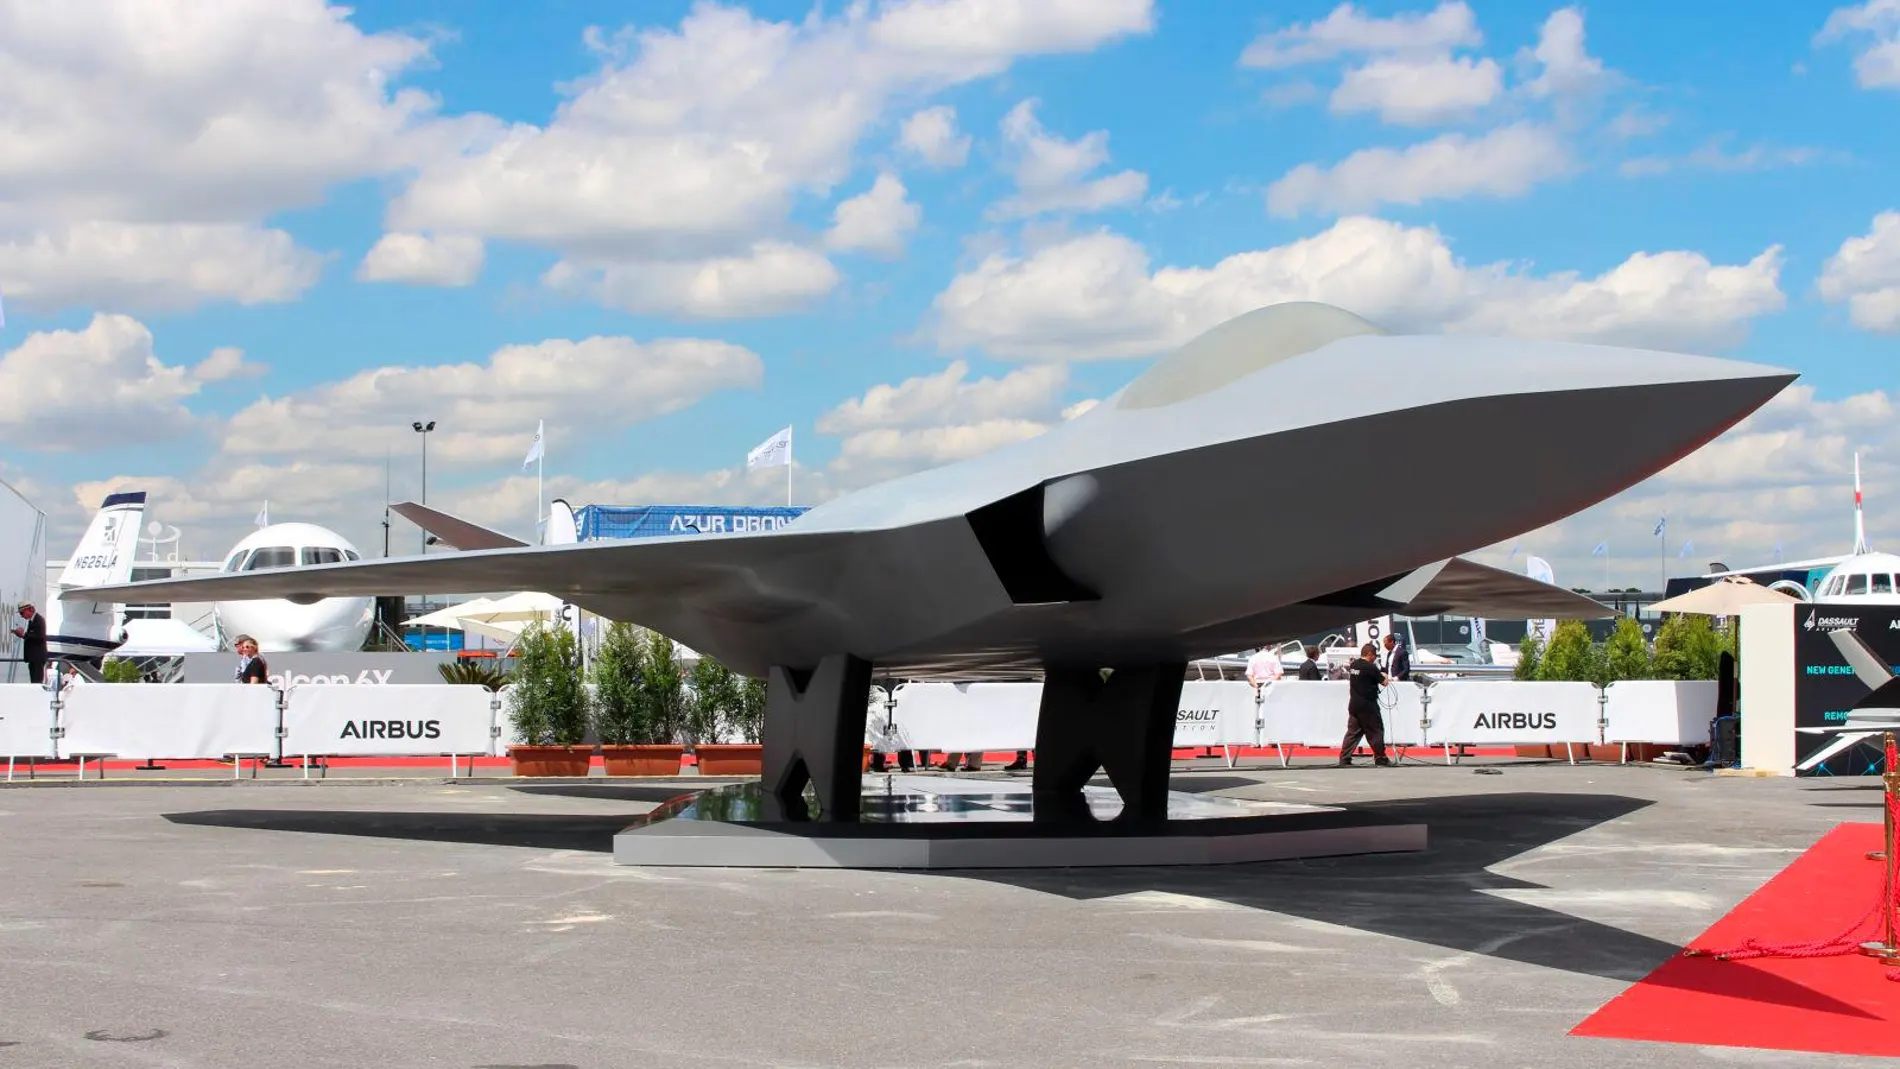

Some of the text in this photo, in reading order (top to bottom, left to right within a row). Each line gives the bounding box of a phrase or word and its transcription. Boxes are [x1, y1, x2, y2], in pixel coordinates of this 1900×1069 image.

[669, 514, 726, 533] AZUR
[1817, 617, 1859, 627] DASSAULT
[1806, 665, 1826, 675] NEW
[340, 719, 441, 739] AIRBUS
[1473, 712, 1557, 729] AIRBUS
